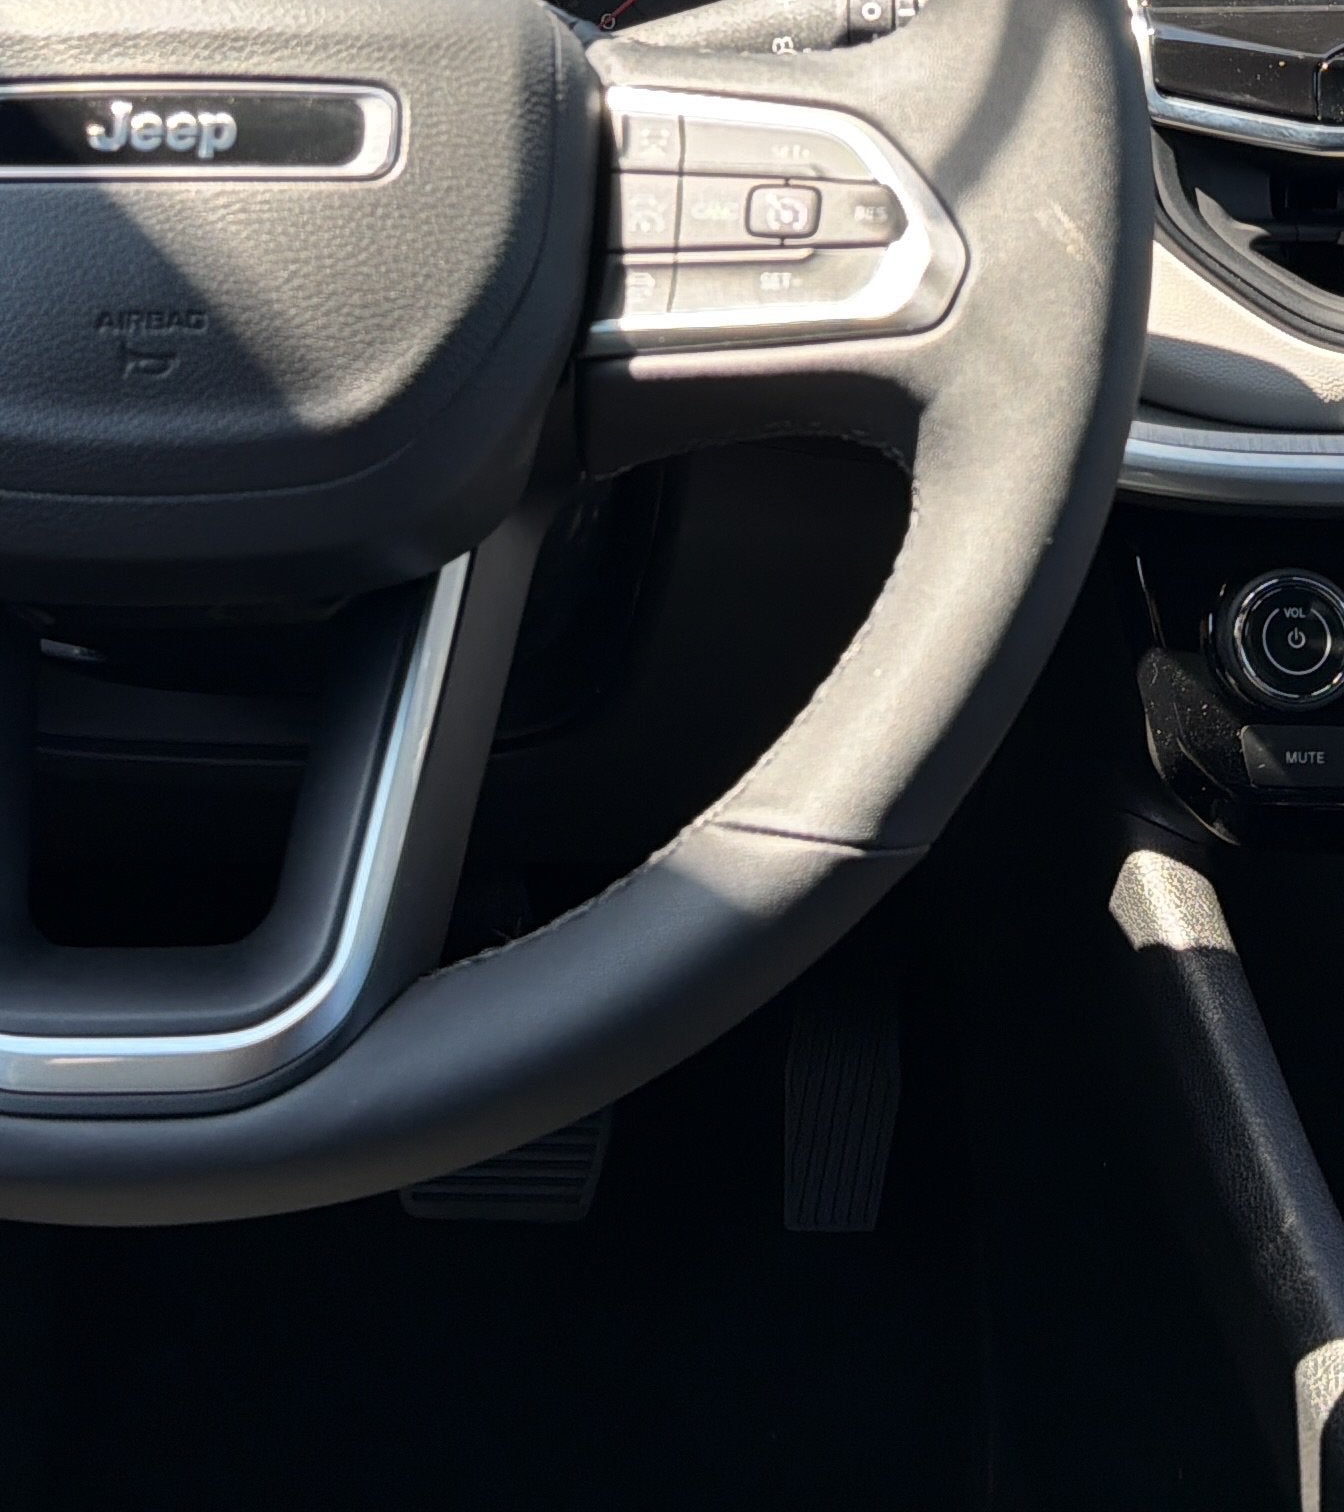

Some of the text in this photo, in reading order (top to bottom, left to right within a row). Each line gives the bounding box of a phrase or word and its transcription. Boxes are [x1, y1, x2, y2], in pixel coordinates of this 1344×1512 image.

[86, 100, 238, 160] Jeep
[93, 309, 209, 336] AIRBAG
[1283, 607, 1307, 620] VOL
[1285, 750, 1326, 765] MUTE
